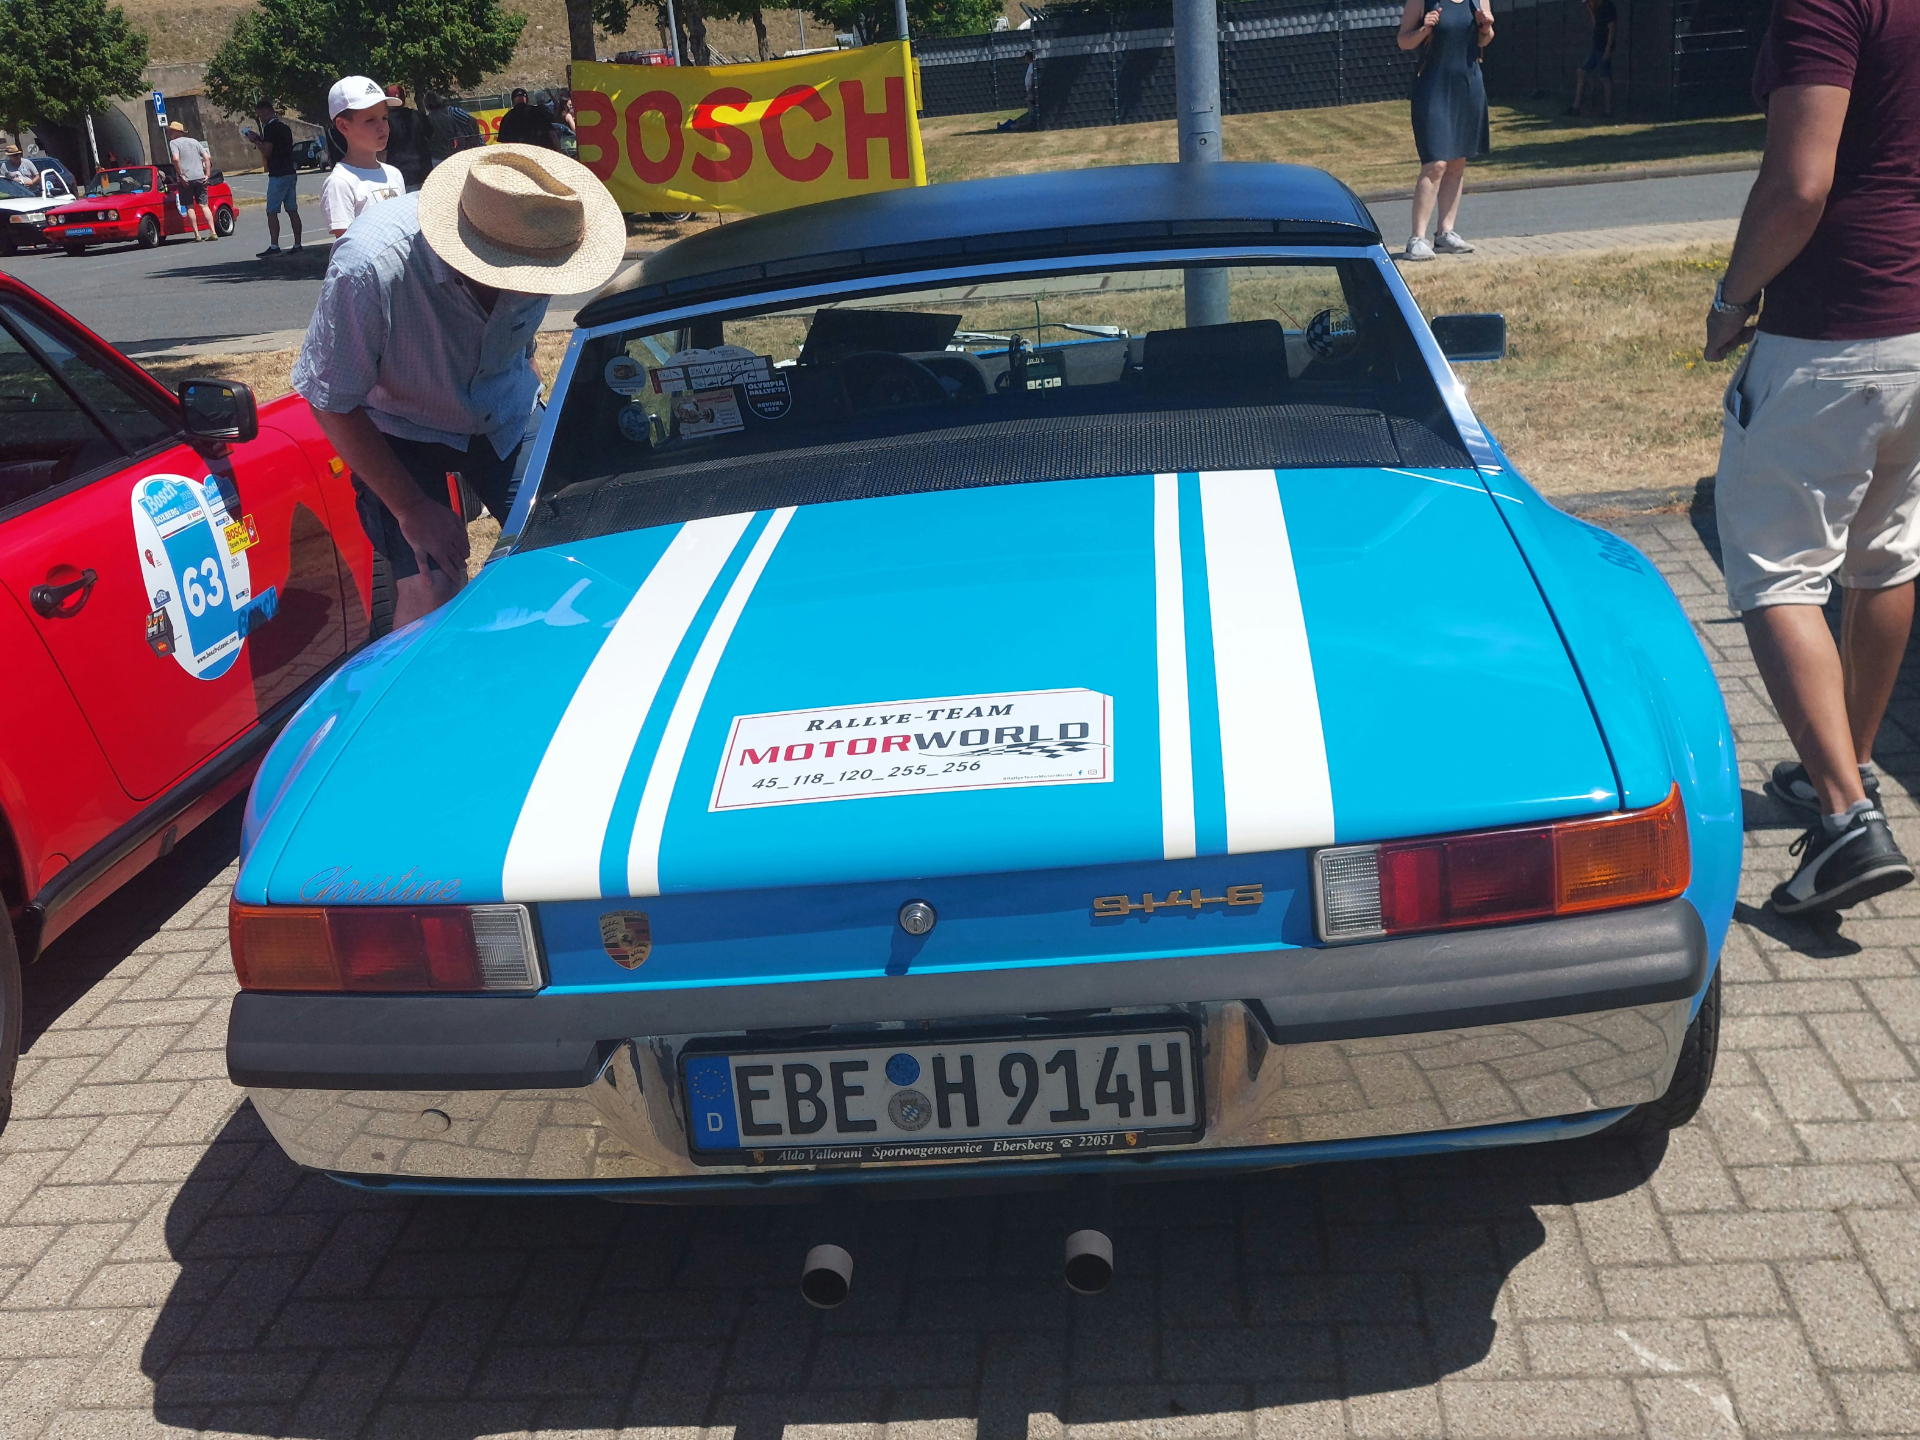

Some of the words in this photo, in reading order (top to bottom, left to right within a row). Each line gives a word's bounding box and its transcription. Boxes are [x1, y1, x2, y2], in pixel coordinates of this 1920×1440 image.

[155, 95, 161, 111] P
[572, 76, 910, 184] BOSCH
[748, 380, 784, 390] OLYMPIA
[749, 386, 786, 396] RALLYE'72
[757, 400, 784, 408] REVIVAL
[146, 480, 178, 516] Bosch
[154, 507, 180, 525] BOXBERG
[226, 524, 247, 542] BOSCH
[230, 541, 240, 549] Spark
[239, 536, 249, 545] Plugs
[183, 557, 224, 617] 63
[805, 703, 1014, 732] RALLYE-TEAM
[739, 721, 1090, 767] MOTORWORLD
[751, 760, 981, 789] 45_118_120_255_256
[300, 865, 461, 902] Christine
[735, 1060, 878, 1137] EBE
[932, 1054, 980, 1128] H
[999, 1042, 1186, 1126] 914H
[706, 1112, 724, 1132] D
[777, 1150, 805, 1161] Aldo
[809, 1147, 863, 1160] Vallorani
[872, 1142, 983, 1159] Sportwagenservice
[993, 1139, 1054, 1152] Ebersberg
[1078, 1134, 1115, 1147] 22051
